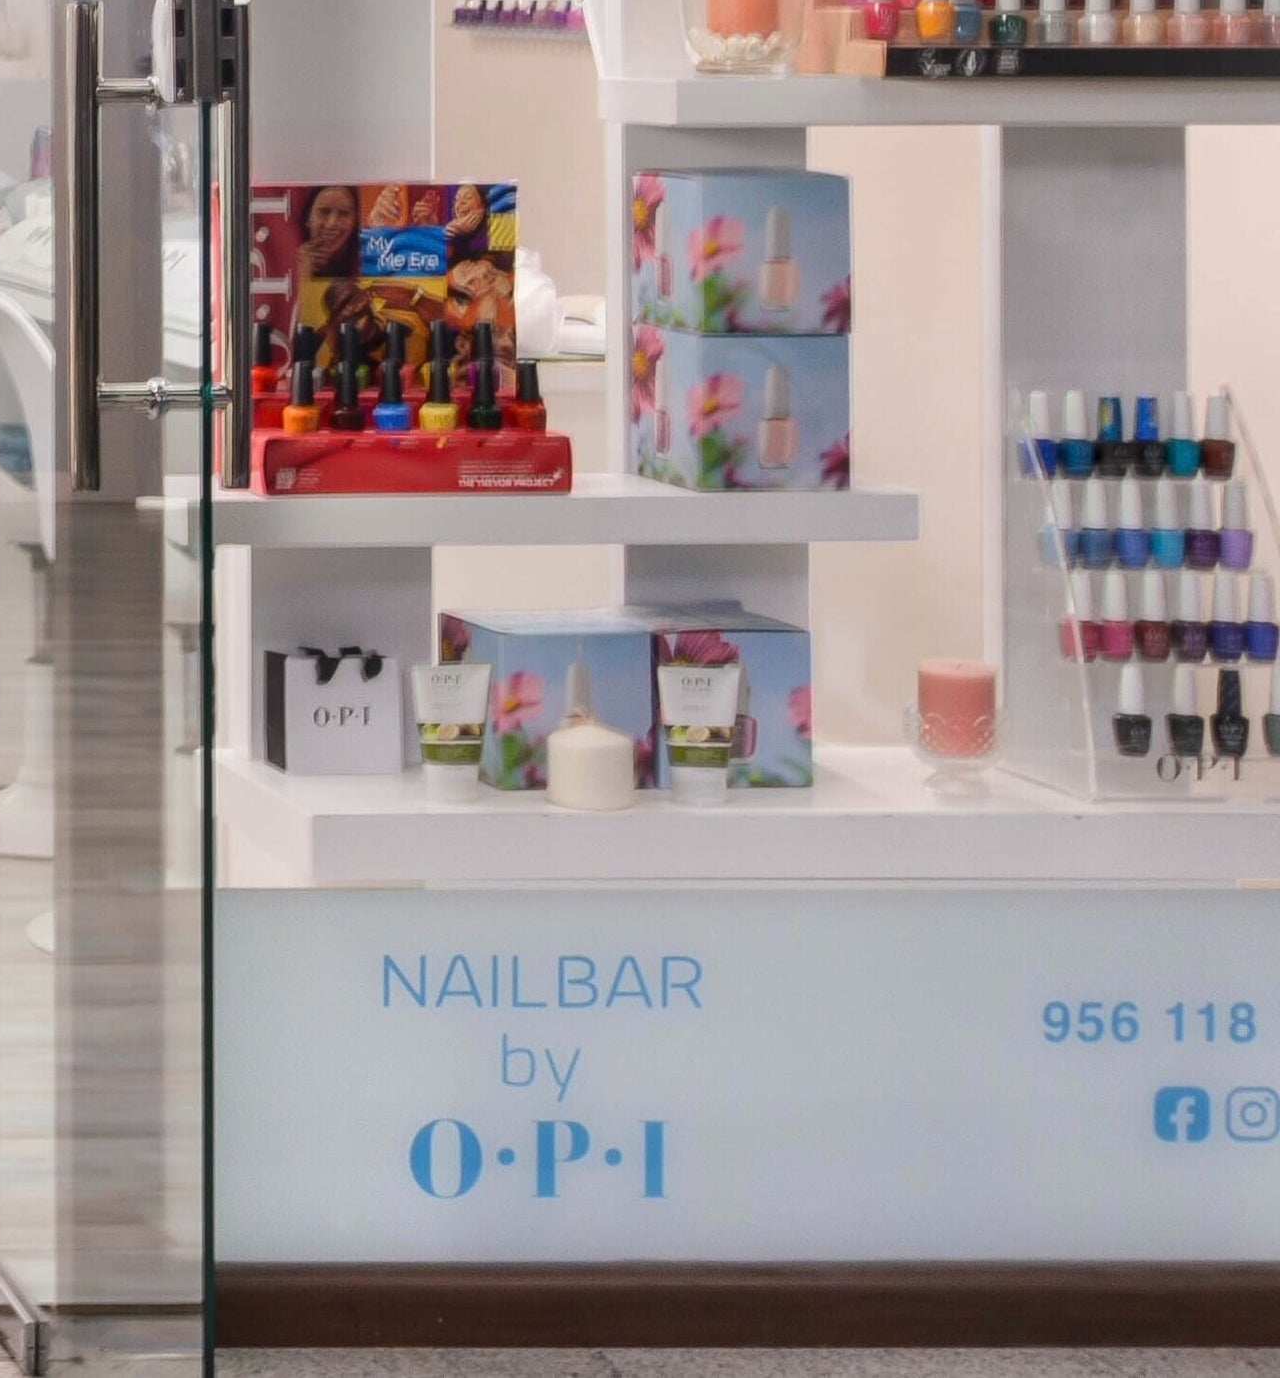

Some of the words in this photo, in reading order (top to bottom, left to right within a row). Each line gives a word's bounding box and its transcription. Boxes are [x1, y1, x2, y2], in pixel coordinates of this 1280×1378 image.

[369, 237, 393, 256] My
[380, 252, 406, 269] Me
[410, 252, 439, 269] Era
[313, 705, 370, 728] O·P·I
[382, 953, 703, 1008] NAILBAR
[1043, 1000, 1140, 1043] 956
[1165, 1000, 1257, 1043] 118
[501, 1032, 581, 1102] by
[408, 1117, 670, 1199] O·P·I
